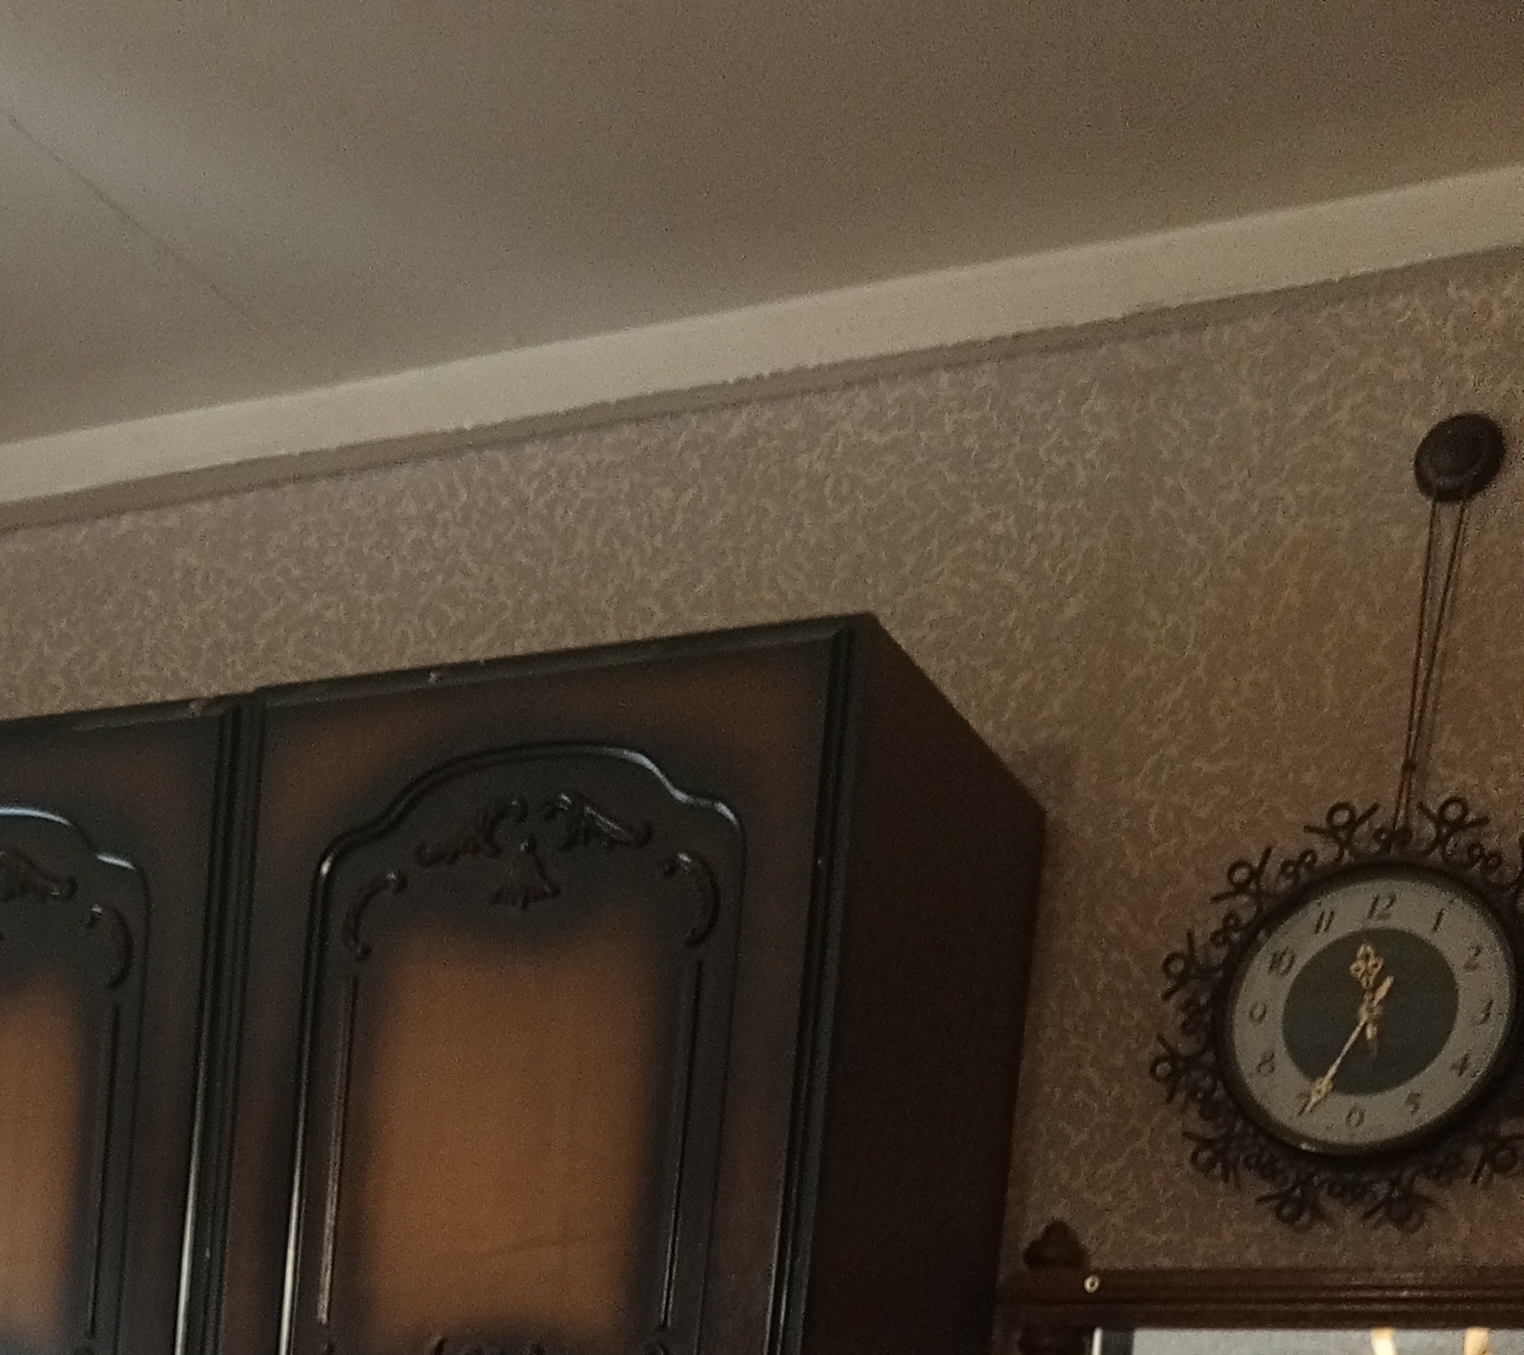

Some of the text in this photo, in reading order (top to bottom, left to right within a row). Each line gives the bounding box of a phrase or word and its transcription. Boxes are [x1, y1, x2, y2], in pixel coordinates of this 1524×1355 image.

[1367, 893, 1397, 919] 12
[1314, 909, 1335, 934] 11
[1431, 908, 1445, 931] 1
[1267, 946, 1295, 976] 10
[1463, 942, 1483, 972] 2
